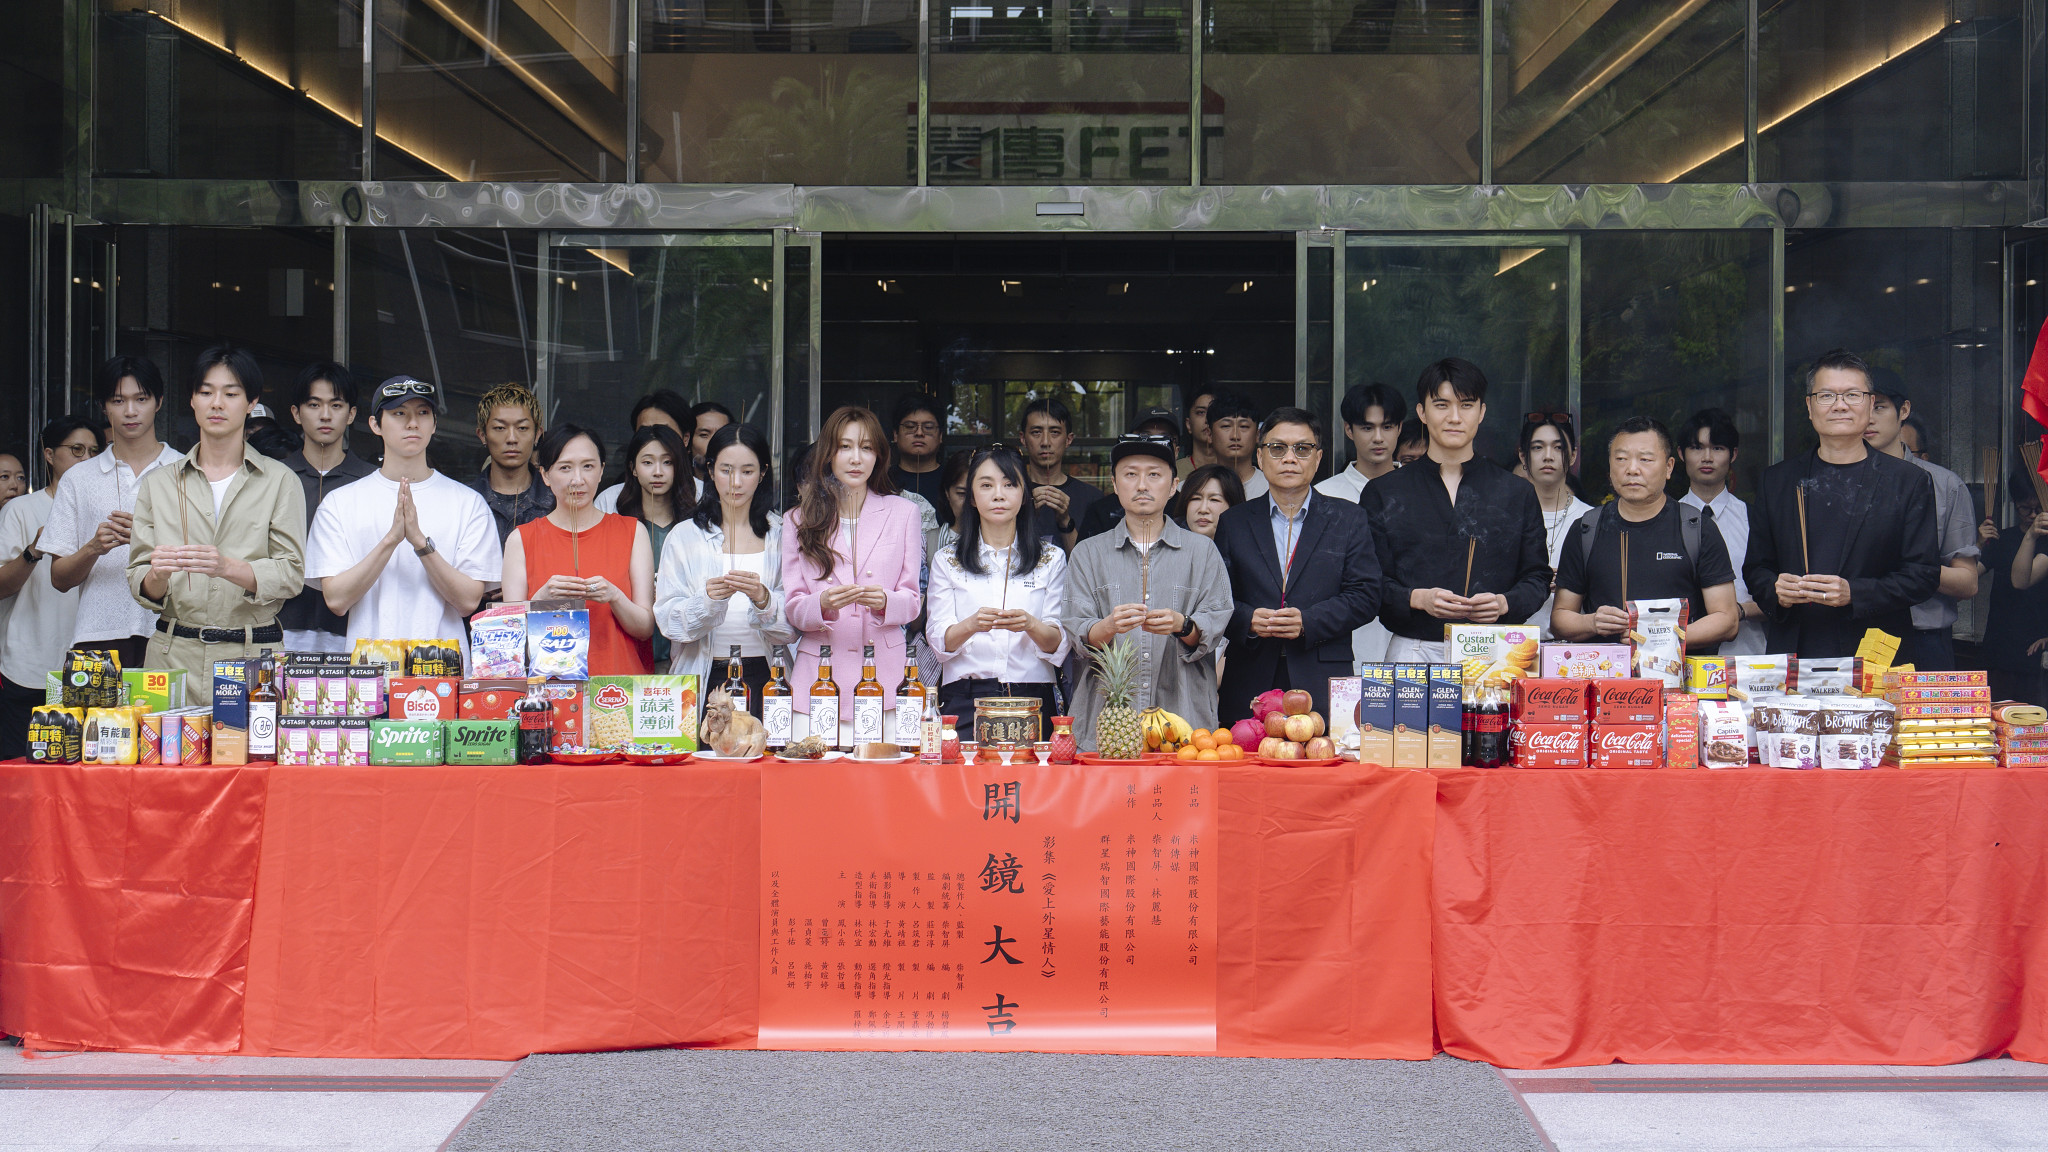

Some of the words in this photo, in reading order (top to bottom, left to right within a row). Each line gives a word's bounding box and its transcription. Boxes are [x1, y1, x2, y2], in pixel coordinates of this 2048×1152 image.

[1080, 126, 1224, 179] FET
[552, 625, 569, 637] 100
[1648, 626, 1671, 634] WALKER'S
[540, 638, 578, 649] SALT
[1457, 633, 1495, 643] Custard
[1463, 643, 1489, 653] Cake
[72, 660, 103, 672] 康貝特
[215, 666, 245, 676] 三冠王
[411, 663, 444, 675] 康貝特
[148, 675, 166, 687] 30
[1364, 669, 1393, 679] 三冠王
[1397, 669, 1427, 679] 三冠王
[1432, 669, 1462, 679] 三冠王
[643, 687, 671, 696] 喜年來
[1527, 686, 1582, 705] Coca-Cola
[1749, 684, 1774, 692] WALKER'S
[1603, 687, 1656, 705] Coca-Cola
[407, 700, 437, 711] Bisco
[640, 698, 675, 713] 蔬菜
[639, 715, 675, 730] 薄餅
[1825, 714, 1869, 730] BROWNIE
[28, 729, 62, 743] 康貝特
[100, 726, 131, 739] 有能量
[377, 726, 431, 748] Sprite
[454, 725, 507, 746] Sprite
[1717, 727, 1740, 736] Captiva
[1528, 731, 1582, 749] Coca-Cola
[1601, 731, 1656, 750] Coca-Cola
[426, 748, 432, 756] 6
[1126, 783, 1137, 809] 製作
[1152, 784, 1163, 821] 出品人
[1189, 784, 1199, 808] 出品
[1042, 835, 1056, 865] 影集
[1170, 834, 1181, 873] 新傳媒
[855, 871, 863, 909] 造型指導
[869, 871, 877, 910] 美術指導
[883, 871, 892, 910] 攝影指導
[978, 780, 1025, 1037] 開鏡大吉
[770, 870, 780, 976] 以及全體演員與工作人員
[804, 918, 813, 947] 溫貞菱
[837, 918, 847, 947] 鳳小岳
[837, 961, 846, 990] 張哲通
